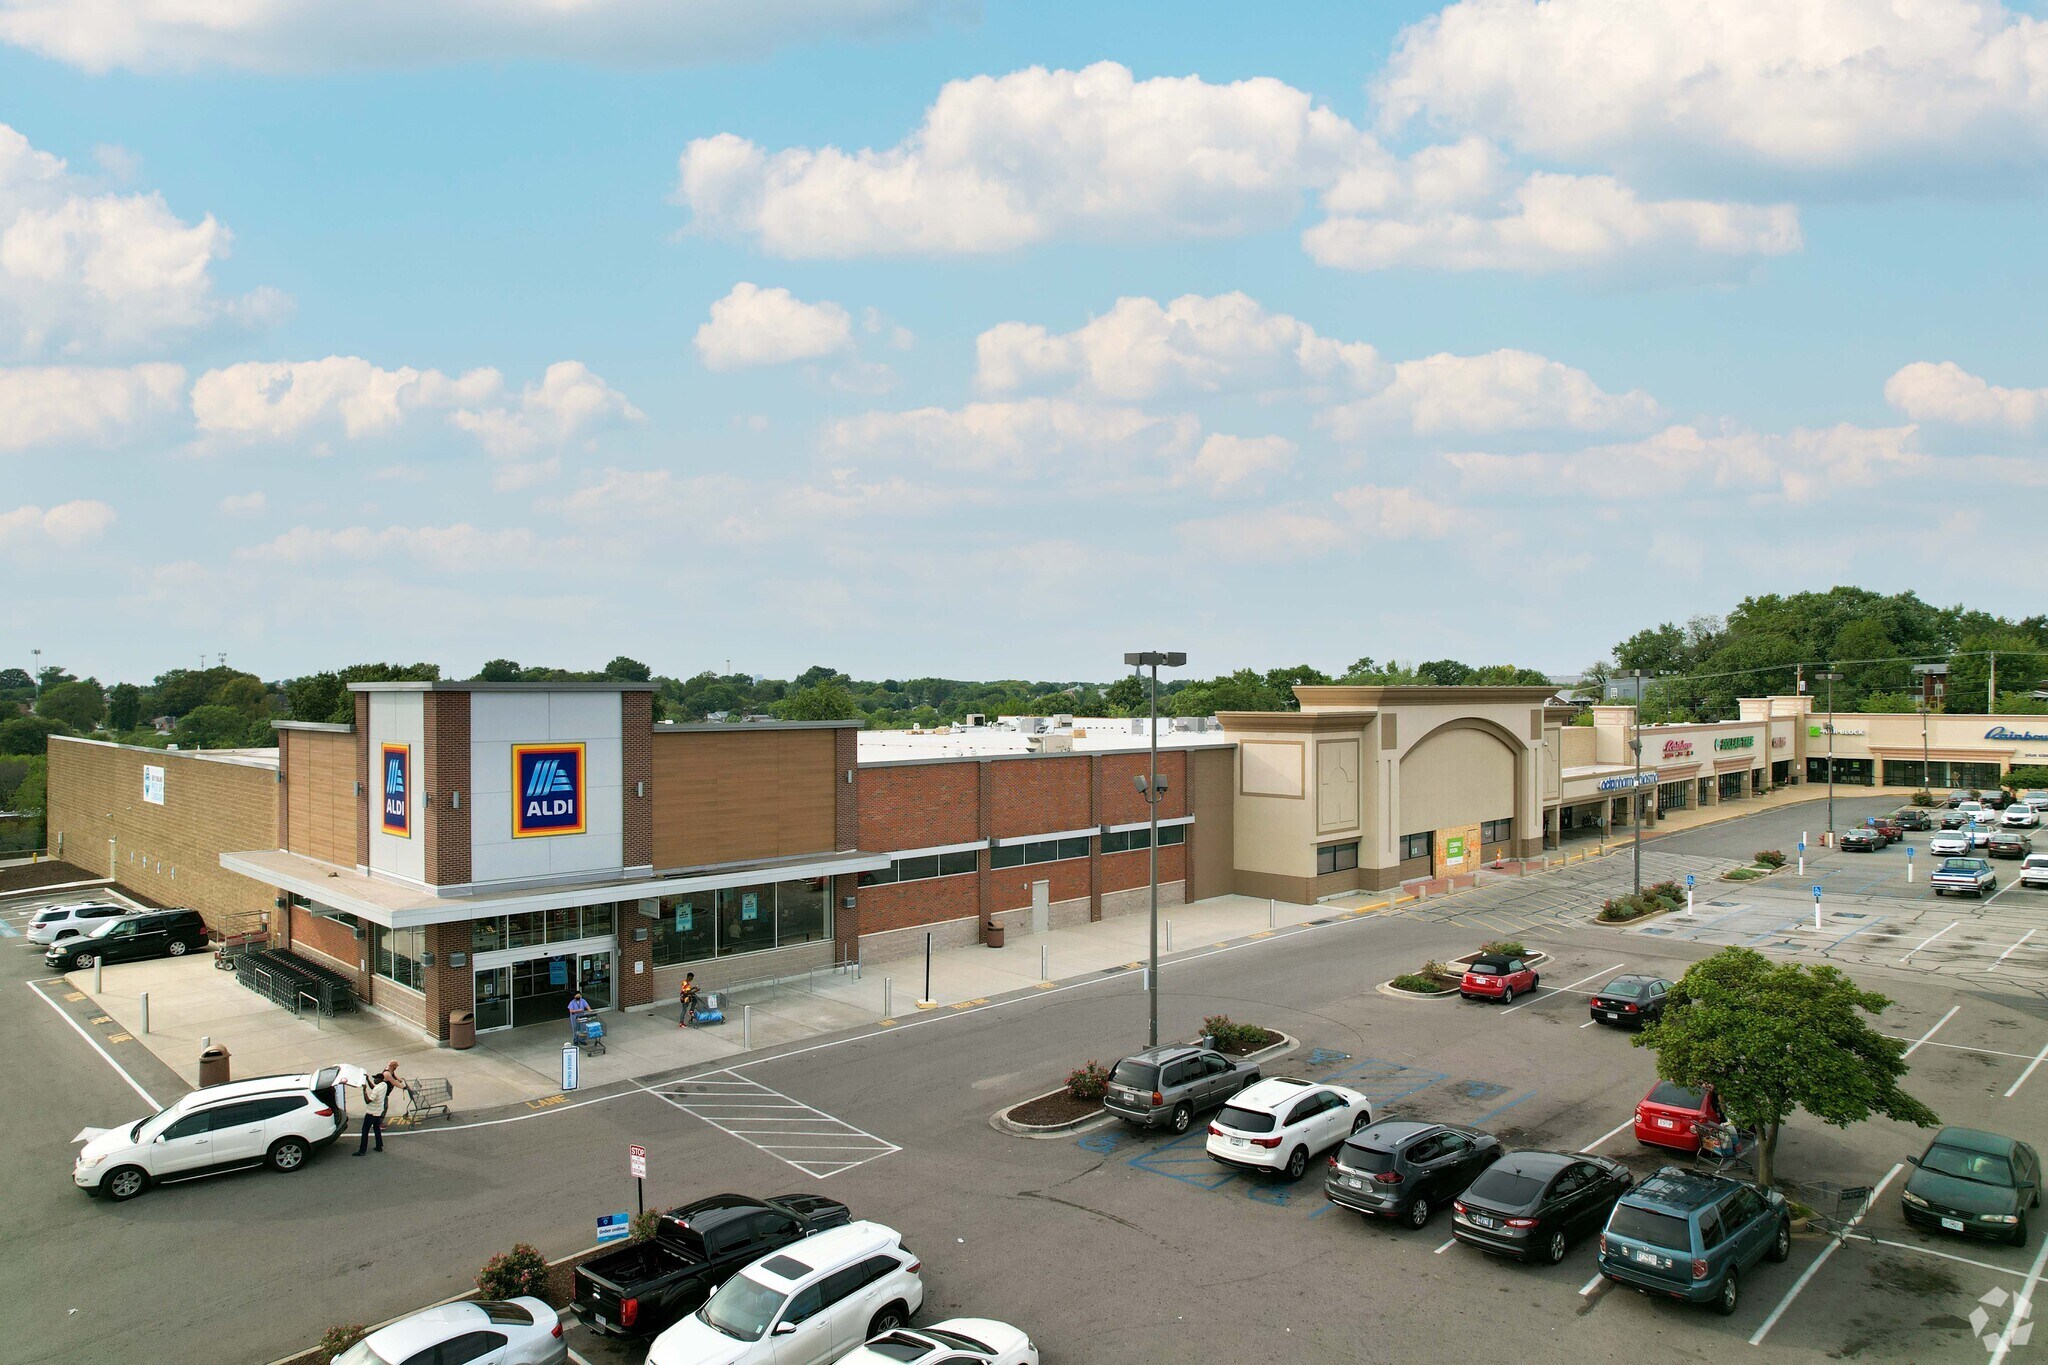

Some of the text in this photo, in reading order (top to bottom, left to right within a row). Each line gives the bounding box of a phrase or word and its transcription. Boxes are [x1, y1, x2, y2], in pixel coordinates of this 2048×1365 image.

[386, 799, 405, 816] ALDI
[526, 799, 574, 817] ALDI
[525, 1094, 570, 1110] LANE
[631, 1147, 645, 1157] STOP
